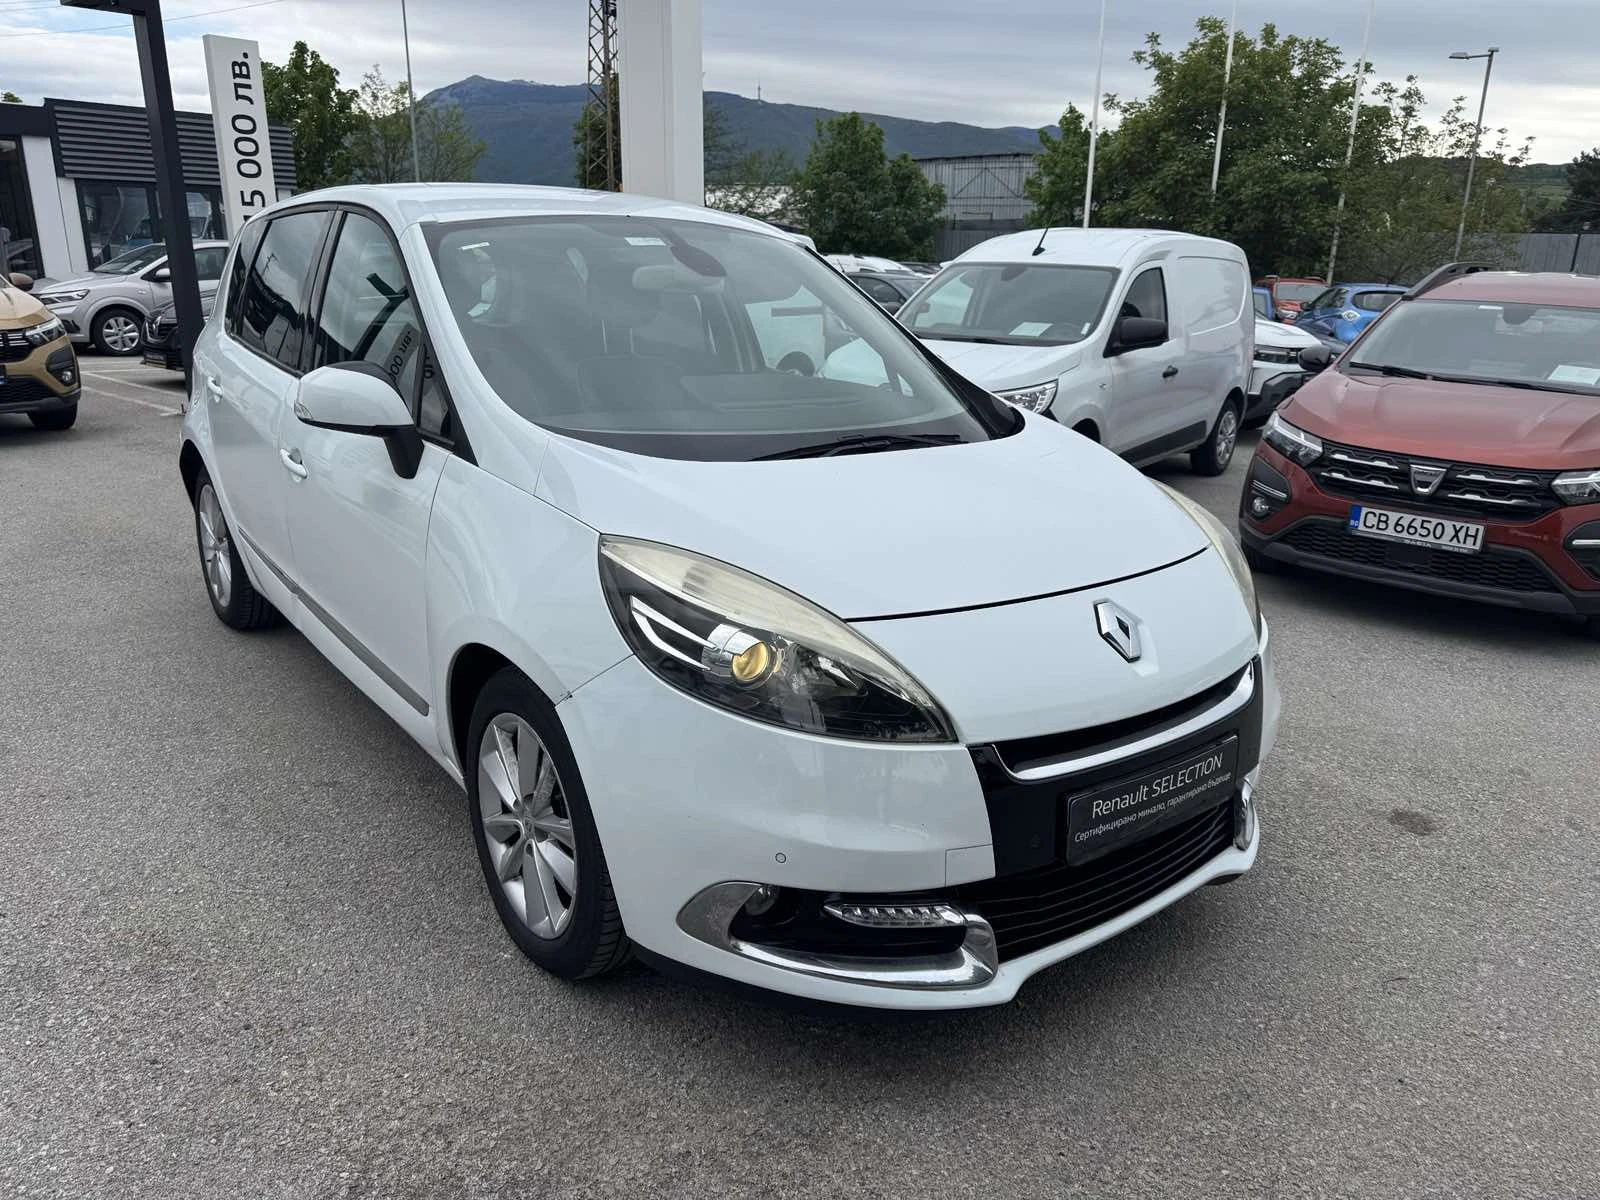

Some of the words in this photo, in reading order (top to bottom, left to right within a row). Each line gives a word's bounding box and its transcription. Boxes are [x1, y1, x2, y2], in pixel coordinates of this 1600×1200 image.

[231, 52, 254, 105] лв.
[231, 114, 262, 178] 000
[240, 190, 266, 221] 5
[1363, 511, 1389, 531] CB
[1393, 515, 1445, 540] 6650
[1449, 523, 1480, 546] XH
[1092, 784, 1149, 819] Renault
[1152, 752, 1223, 797] SELECTION
[1074, 813, 1137, 843] Сертифицирано
